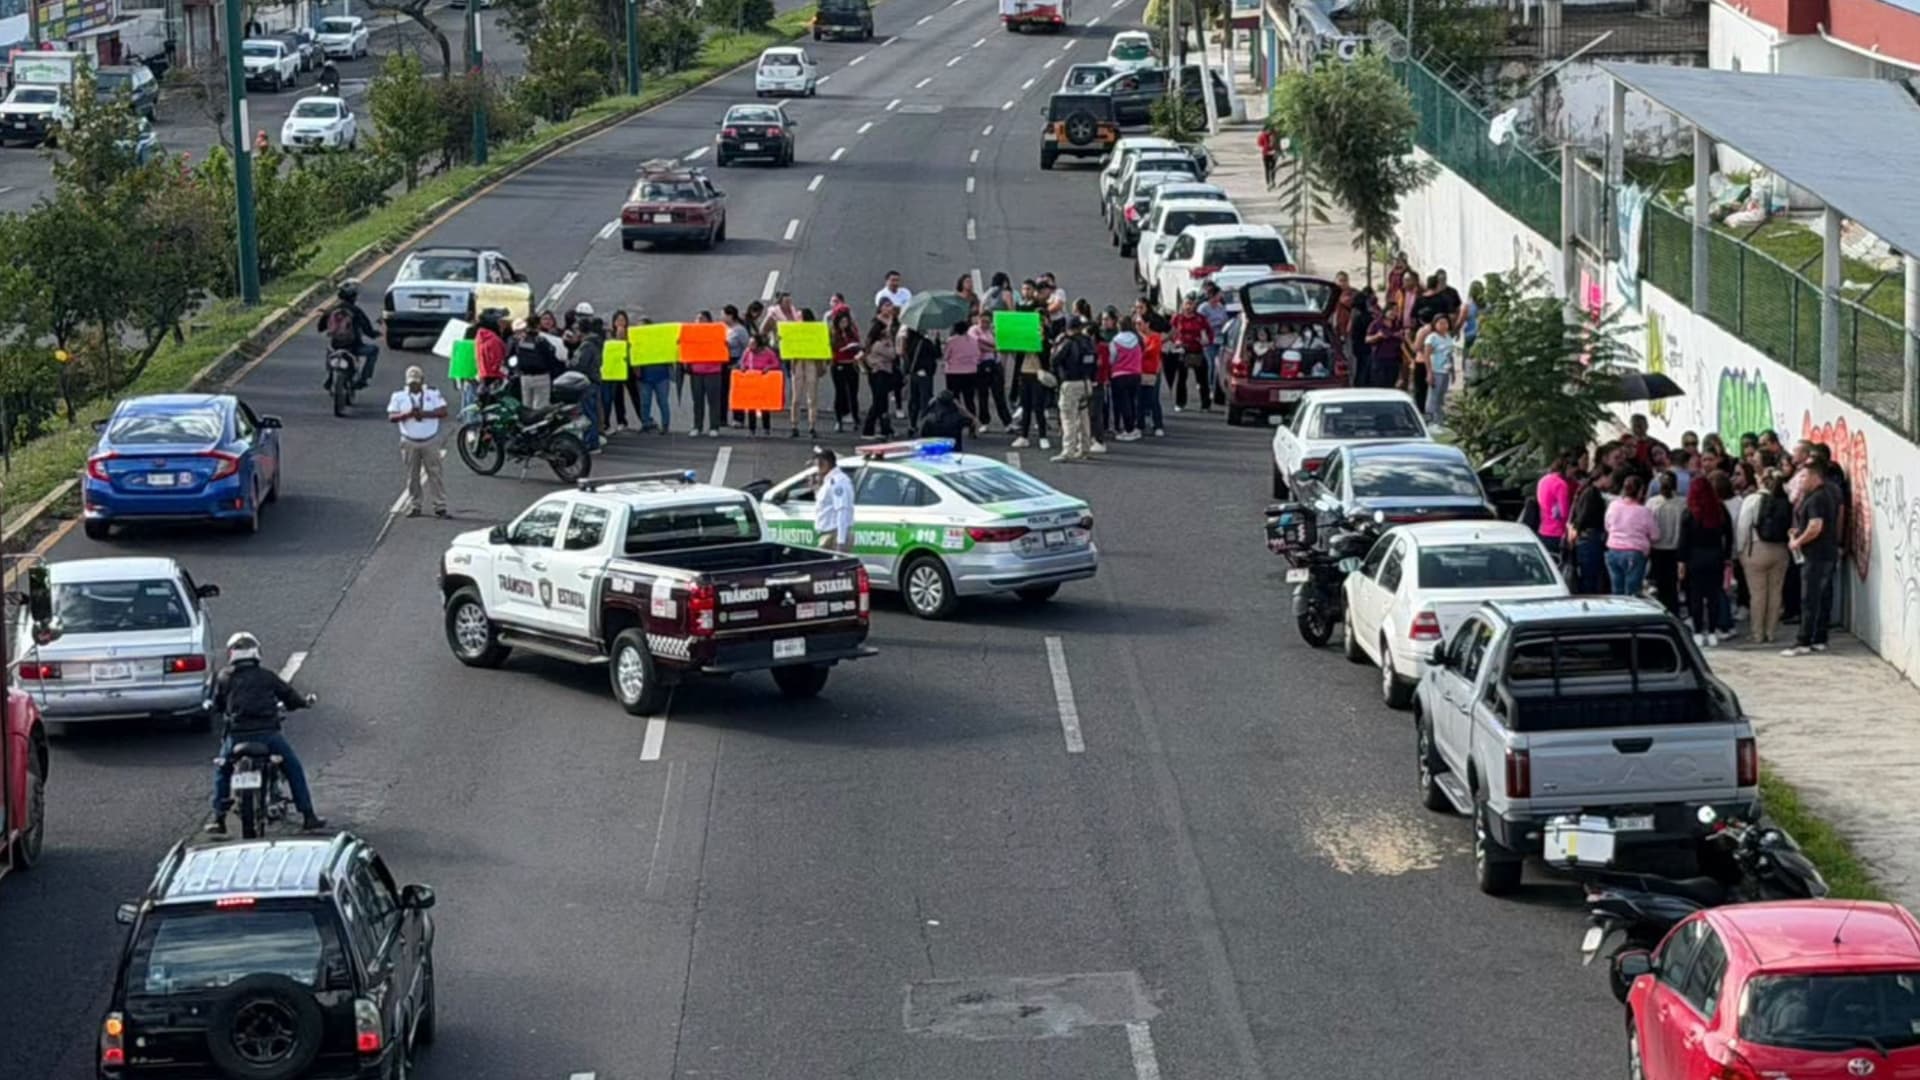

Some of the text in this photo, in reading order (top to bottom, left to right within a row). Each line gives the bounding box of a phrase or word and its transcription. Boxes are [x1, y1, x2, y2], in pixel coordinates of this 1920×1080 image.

[497, 573, 586, 609] TRÁNSITO ESTATAL
[719, 578, 854, 605] TRÁNSITO ESTATAL
